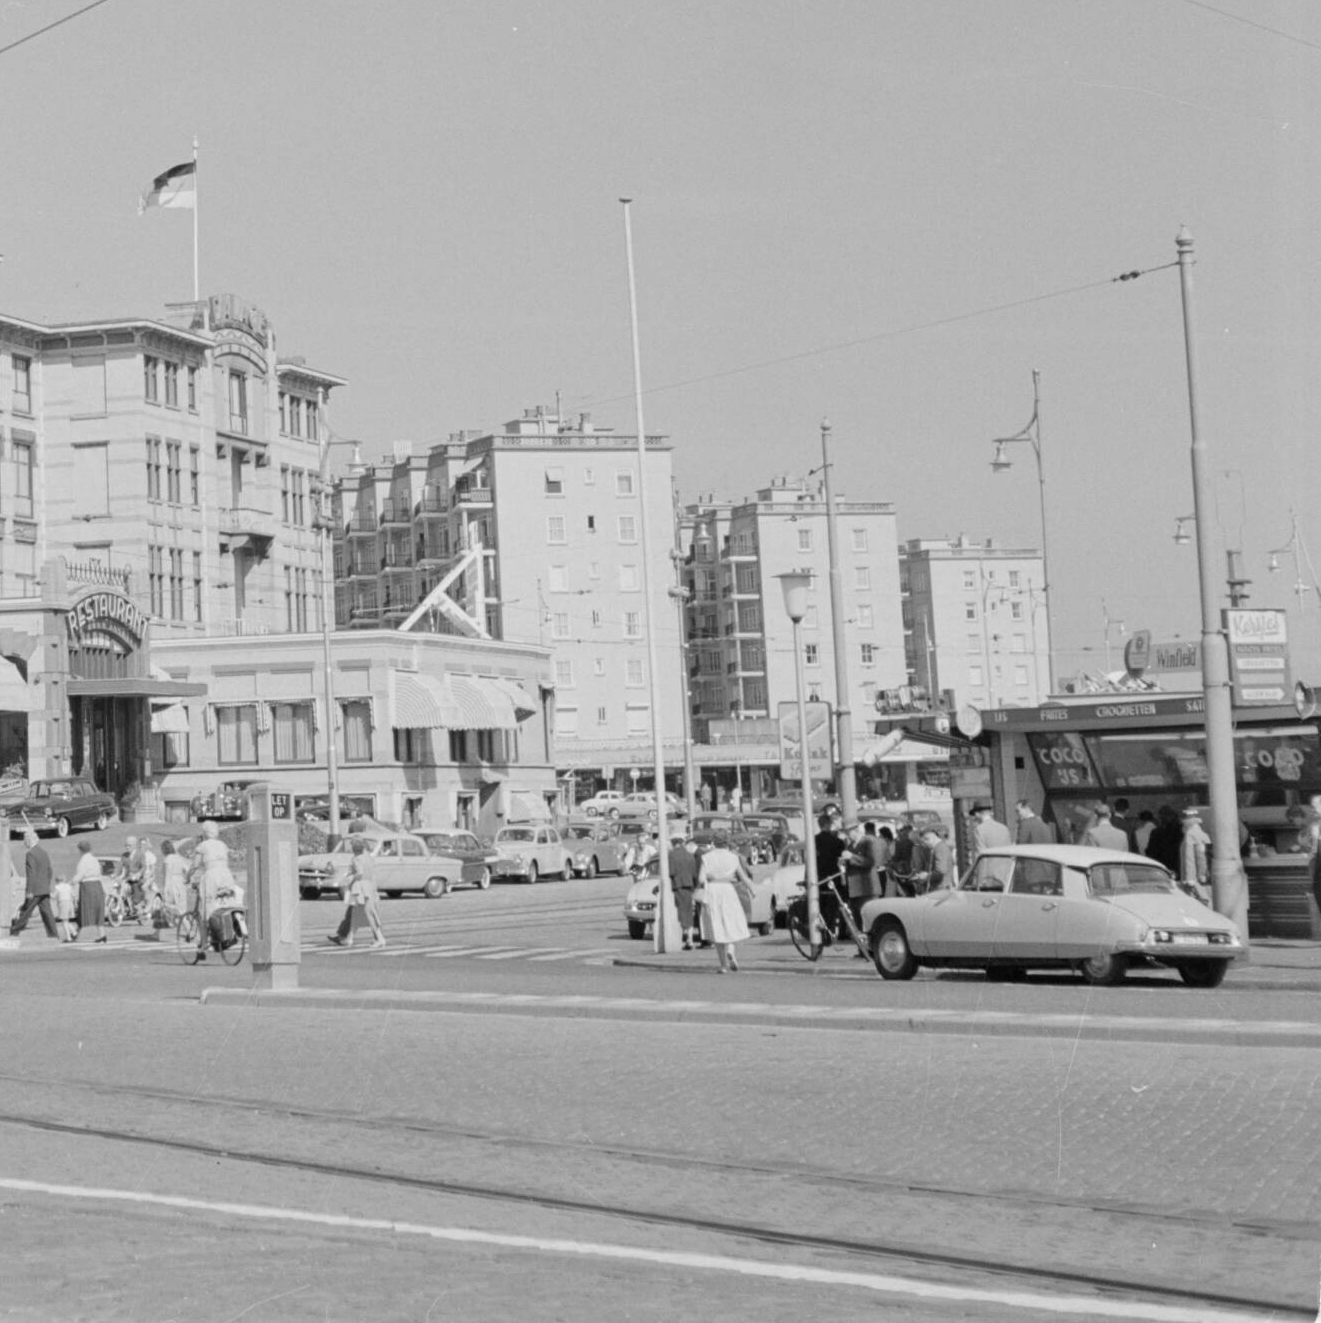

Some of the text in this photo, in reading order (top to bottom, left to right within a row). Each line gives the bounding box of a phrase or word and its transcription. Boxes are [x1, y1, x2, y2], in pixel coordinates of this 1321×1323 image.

[68, 594, 148, 637] RESTAURANT
[1157, 648, 1196, 668] Winfield
[1040, 709, 1069, 721] FRITES
[1095, 703, 1156, 718] CROQUETTEN
[784, 747, 829, 760] Koak
[271, 795, 286, 805] LET
[274, 806, 285, 817] OP
